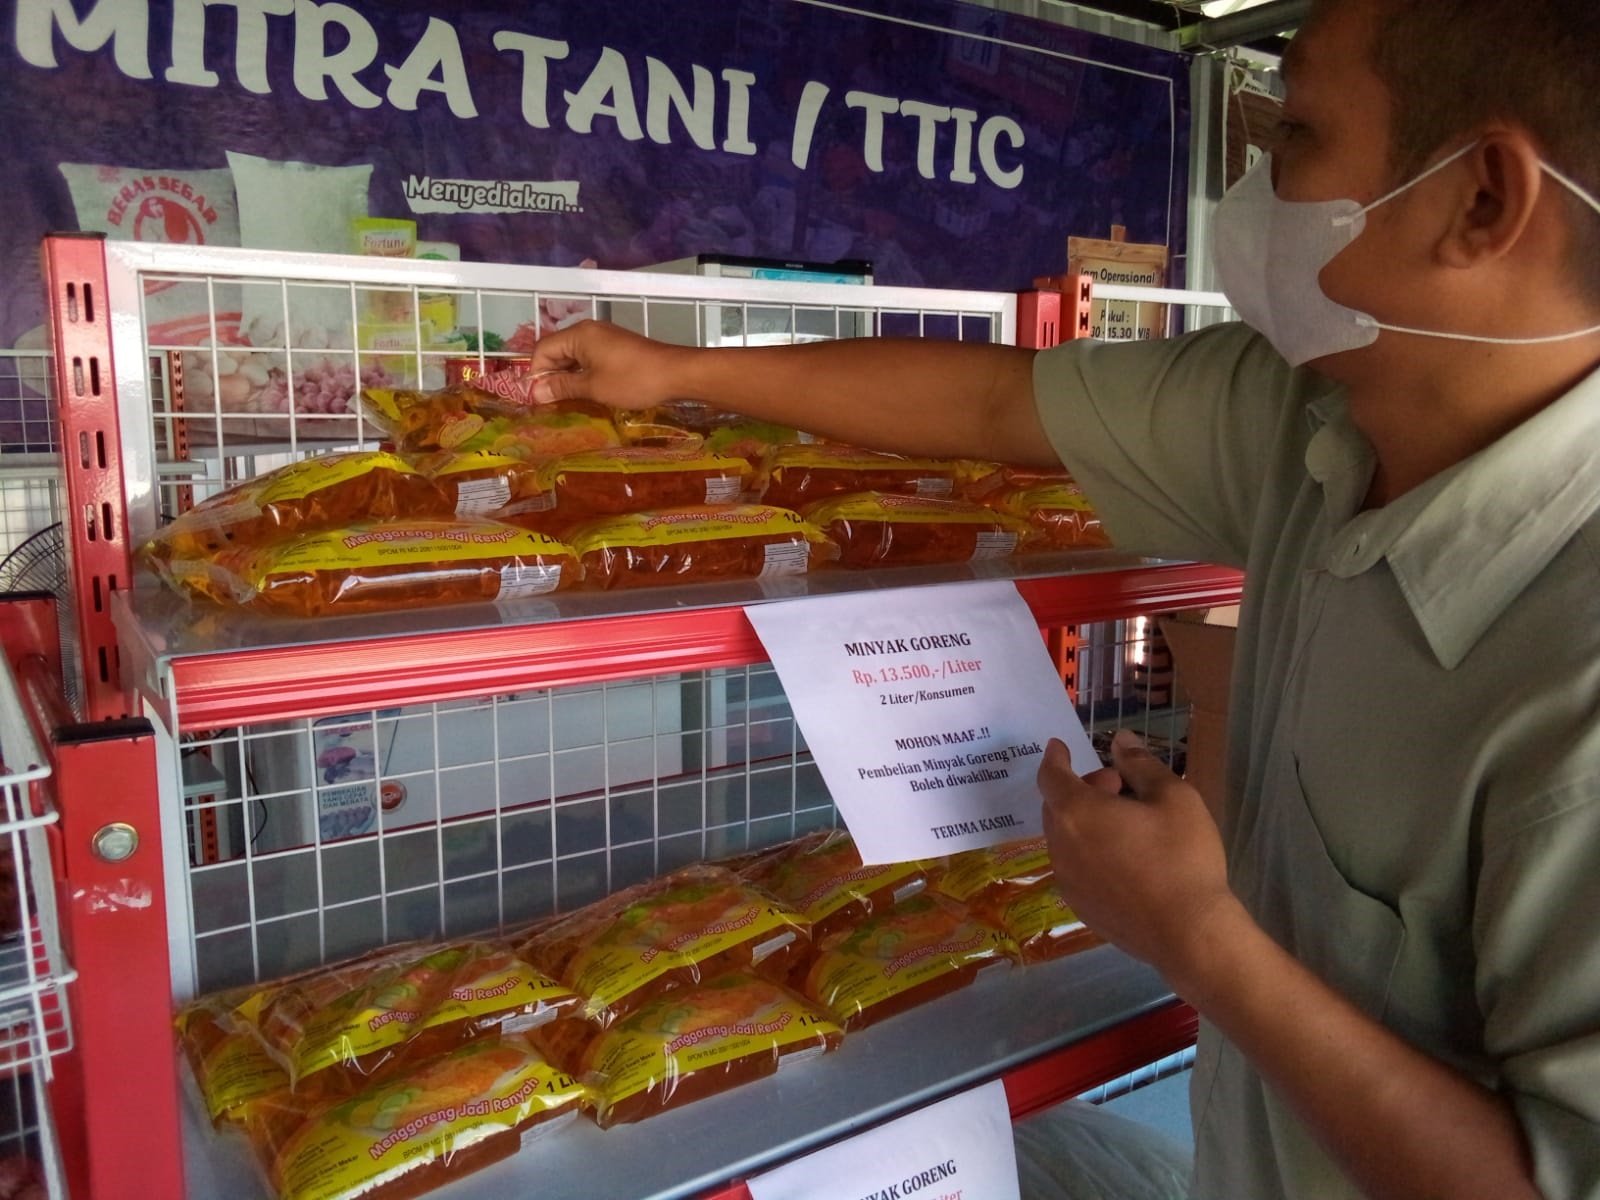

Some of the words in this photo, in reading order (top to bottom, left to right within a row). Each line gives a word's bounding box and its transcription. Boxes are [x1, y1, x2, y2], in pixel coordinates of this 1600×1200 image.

[15, 0, 479, 118] MITRA
[493, 31, 757, 156] TANI
[791, 81, 830, 171] /
[845, 91, 1025, 189] TTIC
[107, 175, 155, 226] BERAS
[158, 176, 218, 225] SEGAR
[407, 173, 584, 213] Menyediakan...
[1100, 268, 1155, 284] Operasional
[342, 529, 434, 550] Menggoreng
[438, 528, 469, 543] Jadi
[472, 527, 520, 544] Renyah
[527, 533, 536, 544] 1
[843, 639, 909, 656] MINYAK
[910, 632, 972, 651] GORENG
[852, 669, 877, 687] Rp.
[880, 694, 887, 705] 2
[888, 685, 976, 705] Liter/Konsumen
[894, 734, 941, 751] MOHON
[857, 763, 922, 780] Pembelian
[922, 754, 966, 772] Minyak
[966, 748, 1010, 764] Goreng
[1008, 742, 1043, 757] Tidak
[910, 775, 945, 793] Boleh
[946, 767, 1009, 787] diwakilkan
[931, 821, 979, 840] TERIMA
[477, 975, 521, 1000] Renyah
[730, 1023, 755, 1035] Jadi
[758, 1012, 793, 1034] Renyah
[546, 1080, 555, 1093] 1
[368, 1106, 457, 1161] Menggoreng
[457, 1101, 490, 1118] Jadi
[493, 1076, 540, 1110] Renyah
[902, 1159, 957, 1195] GORENG
